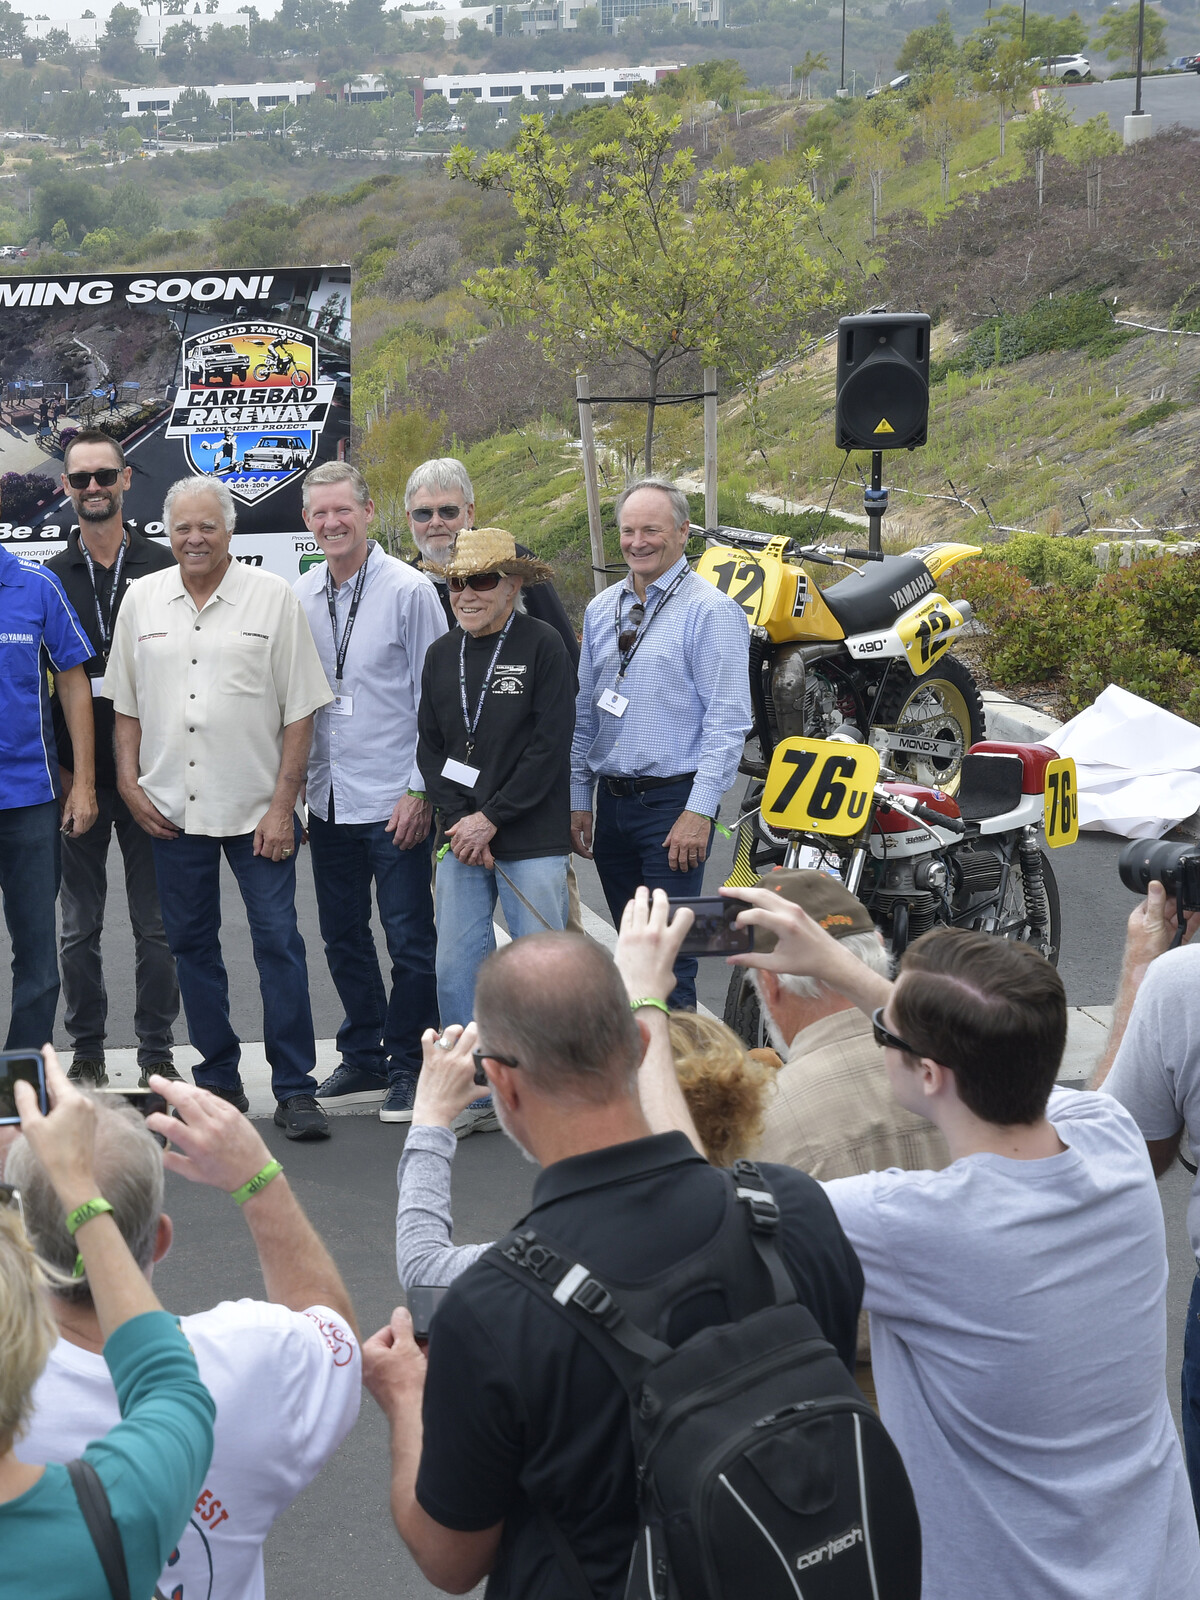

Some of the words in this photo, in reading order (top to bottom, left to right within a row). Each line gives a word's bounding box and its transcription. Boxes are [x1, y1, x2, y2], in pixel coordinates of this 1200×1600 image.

[125, 276, 274, 302] SOON!
[196, 326, 247, 344] WORLD
[250, 325, 304, 341] FAMOUS
[187, 388, 318, 407] CARLSBAD
[187, 405, 316, 425] RACEWAY
[195, 425, 258, 433] MONUMENT
[40, 525, 61, 538] a
[17, 558, 40, 570] YAMAHA
[712, 560, 766, 615] 12
[889, 572, 934, 611] YAMAHA
[8, 632, 34, 642] YAMAHA
[858, 640, 883, 653] 490
[915, 610, 951, 664] 12
[500, 680, 516, 691] 35
[899, 738, 941, 752] MONO-X
[796, 1527, 863, 1571] cortech
